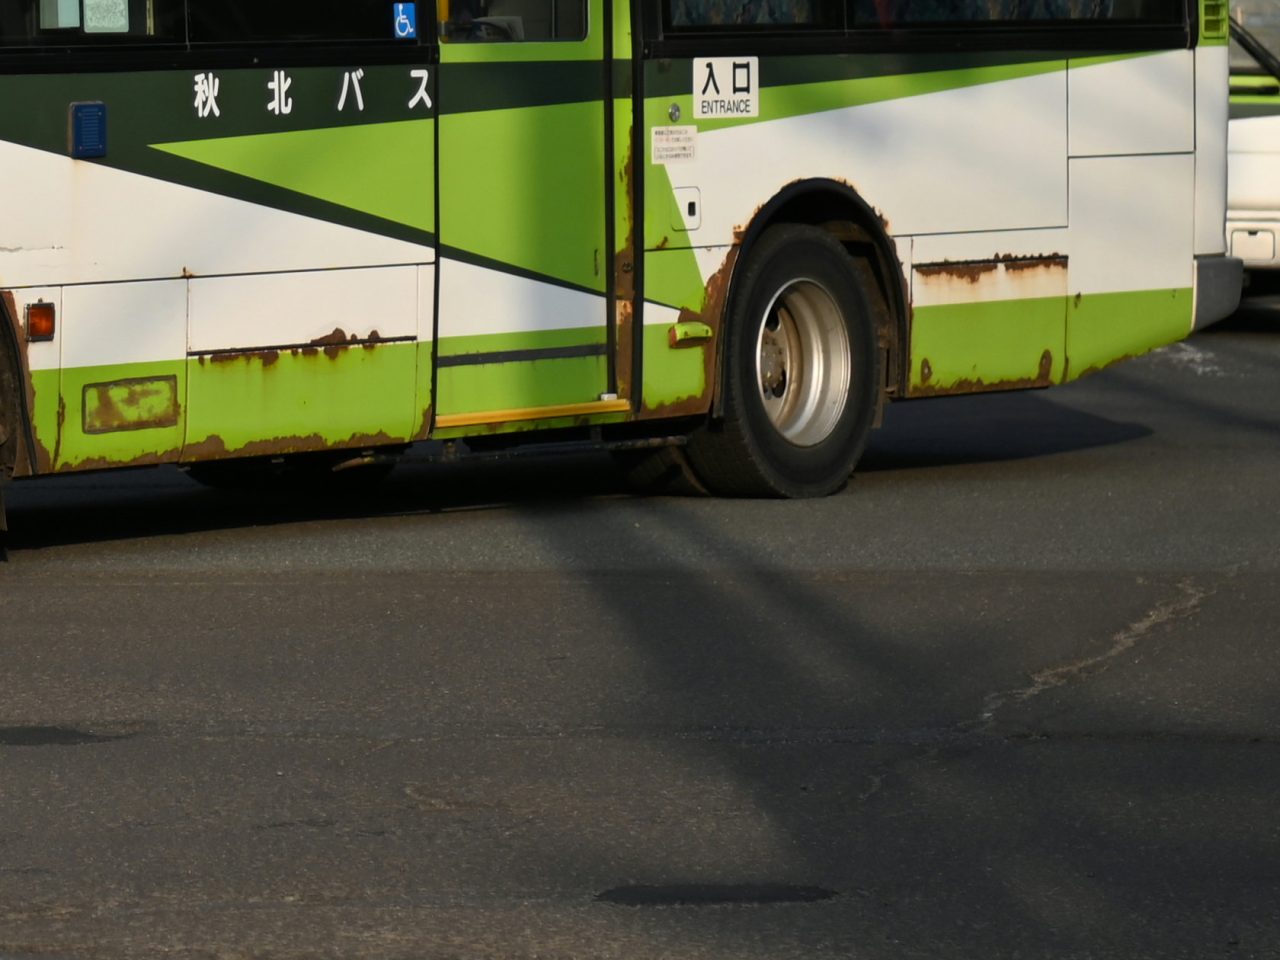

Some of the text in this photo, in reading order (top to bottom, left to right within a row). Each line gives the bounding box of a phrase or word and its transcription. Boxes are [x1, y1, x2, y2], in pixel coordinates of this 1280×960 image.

[194, 69, 432, 118] 秋北バス
[702, 61, 751, 95] 入口
[701, 99, 751, 113] ENTRANCE
